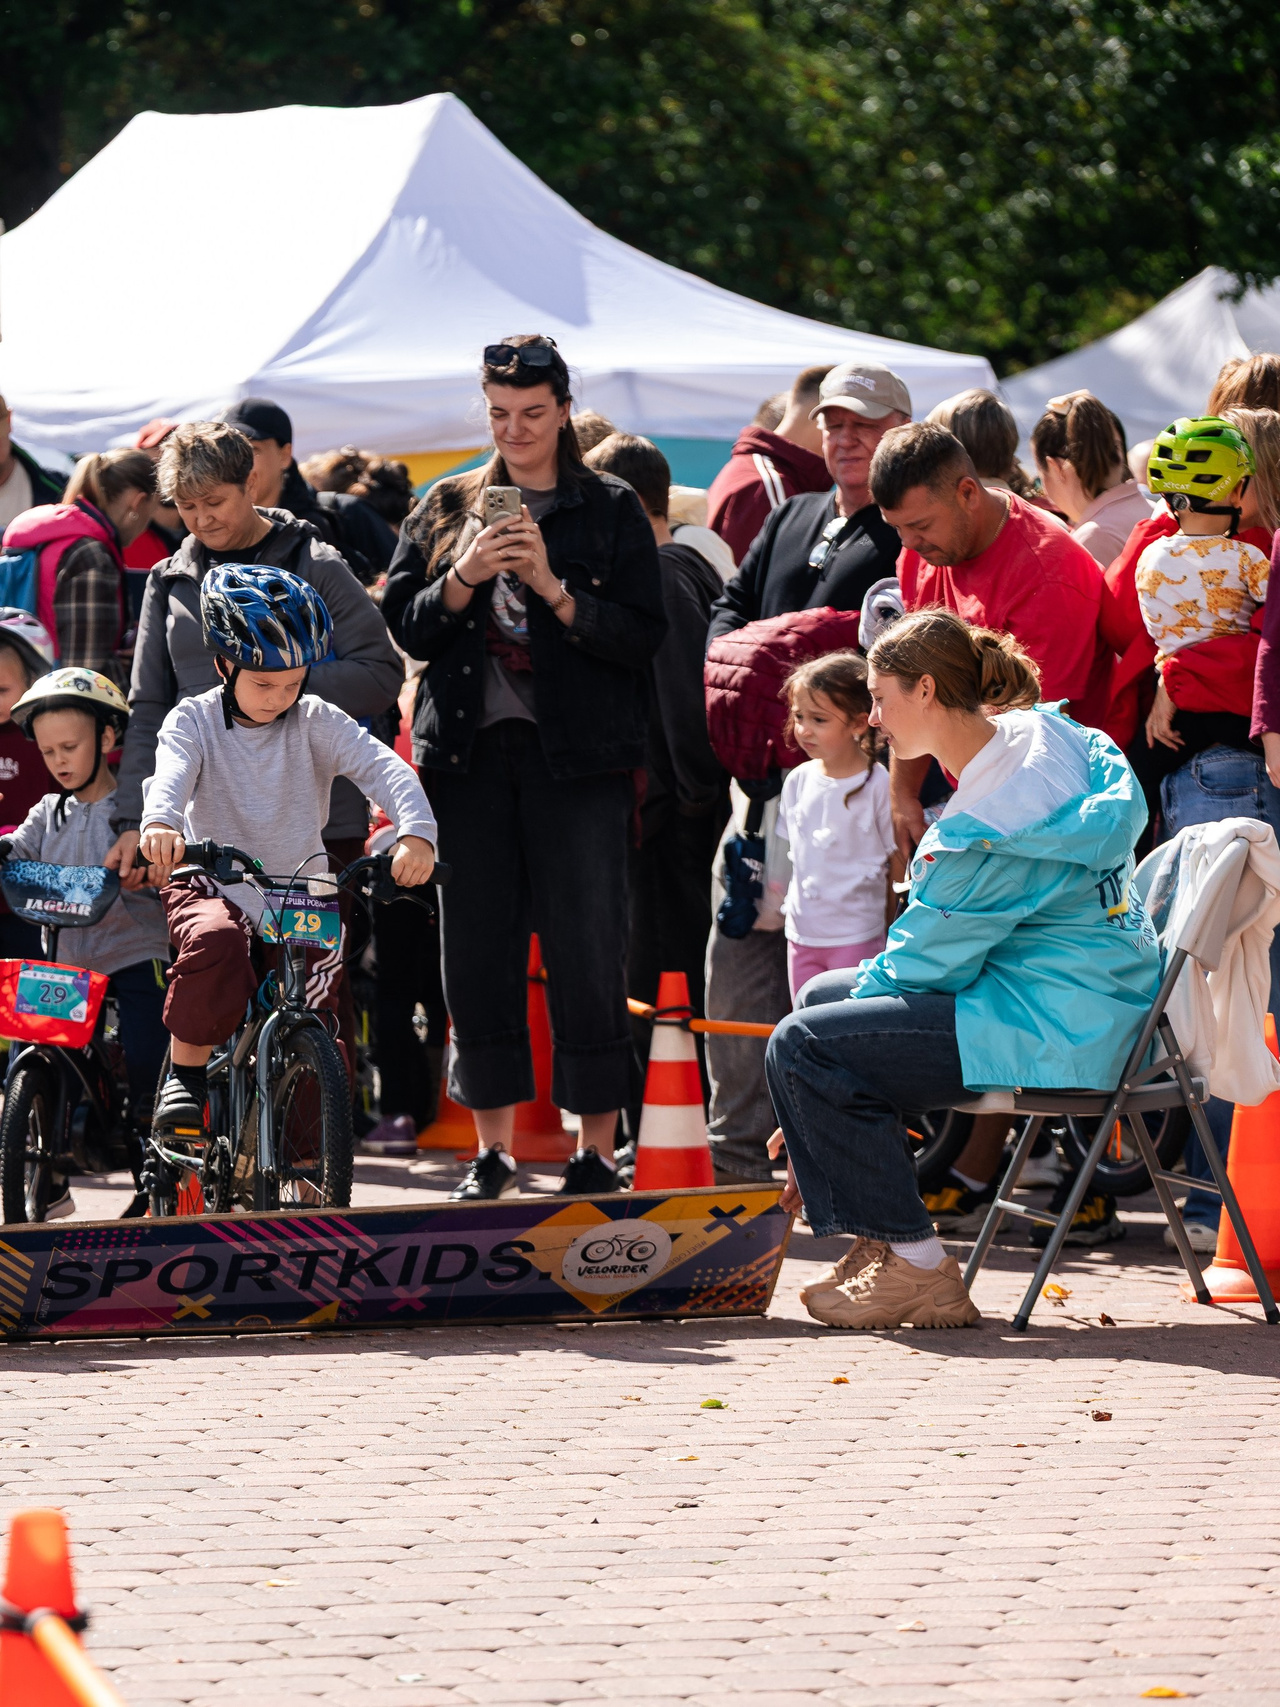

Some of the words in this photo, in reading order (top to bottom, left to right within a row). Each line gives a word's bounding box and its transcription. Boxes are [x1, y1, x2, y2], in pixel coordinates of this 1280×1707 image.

[23, 898, 92, 916] JAGUAR
[293, 911, 322, 933] 29
[39, 983, 67, 1005] 29
[40, 1240, 566, 1301] SPORTKIDS.
[577, 1264, 649, 1277] VELORIDER
